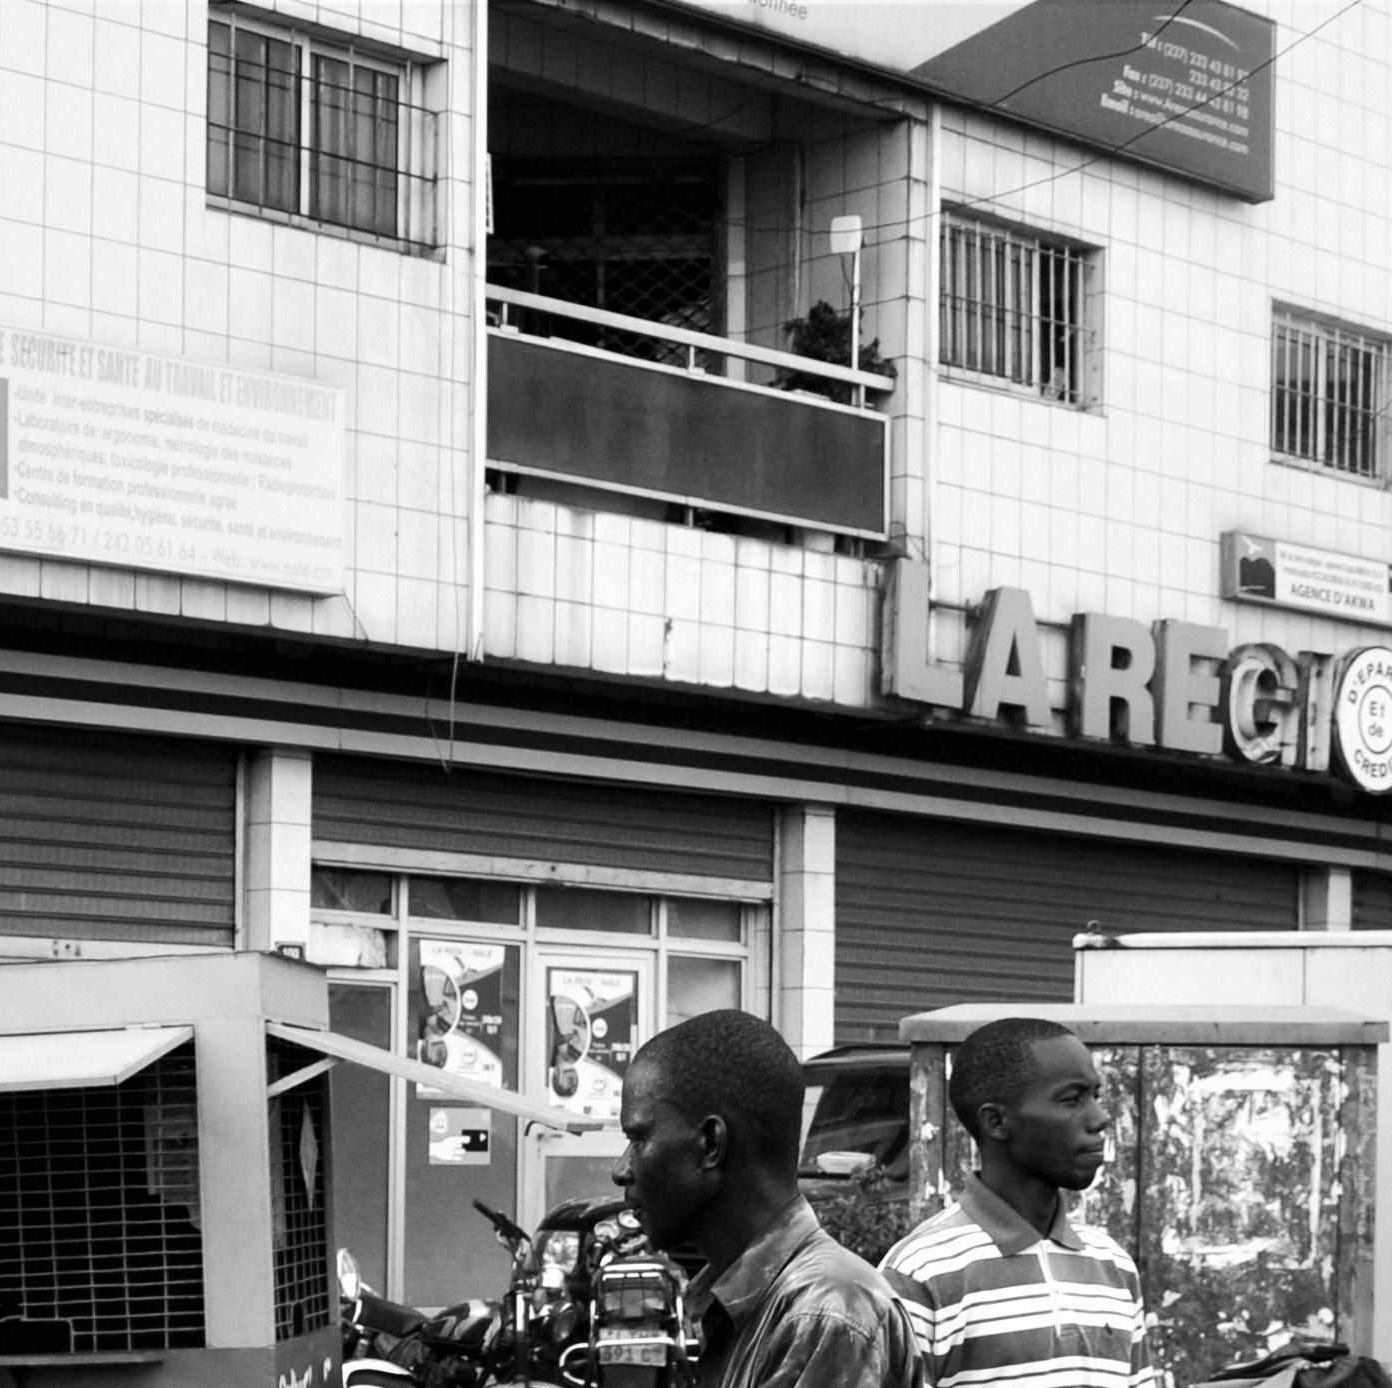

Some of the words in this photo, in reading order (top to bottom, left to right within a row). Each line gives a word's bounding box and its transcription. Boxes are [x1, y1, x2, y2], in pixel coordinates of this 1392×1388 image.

[748, 0, 807, 19] onnée
[79, 346, 94, 379] ET
[144, 357, 162, 392] AU
[166, 362, 217, 402] TRAVAIL
[220, 372, 233, 405] ET
[236, 374, 337, 423] ENVIRONNEMENT
[53, 393, 140, 421] inter-entreprises
[143, 407, 195, 430] spécialisée
[197, 415, 209, 431] de
[212, 419, 260, 440] médecine
[263, 427, 276, 443] du
[278, 429, 309, 449] travail
[221, 444, 240, 461] des
[242, 449, 293, 471] nuisances
[56, 470, 71, 485] de
[73, 471, 124, 493] formation
[127, 480, 207, 505] professionnelle
[111, 453, 169, 478] toxicologie
[171, 463, 249, 487] professionnelle
[258, 474, 336, 500] Radioprotection
[25, 519, 42, 541] 55
[48, 523, 65, 544] 66
[71, 525, 86, 548] 71
[104, 531, 129, 553] 242
[134, 535, 152, 556] 05
[157, 538, 173, 560] 61
[179, 541, 196, 561] 64
[80, 500, 94, 514] en
[257, 525, 268, 540] et
[269, 529, 343, 549] environnement
[1290, 583, 1331, 603] AGENCE
[1369, 701, 1385, 718] Et
[1368, 723, 1384, 738] de
